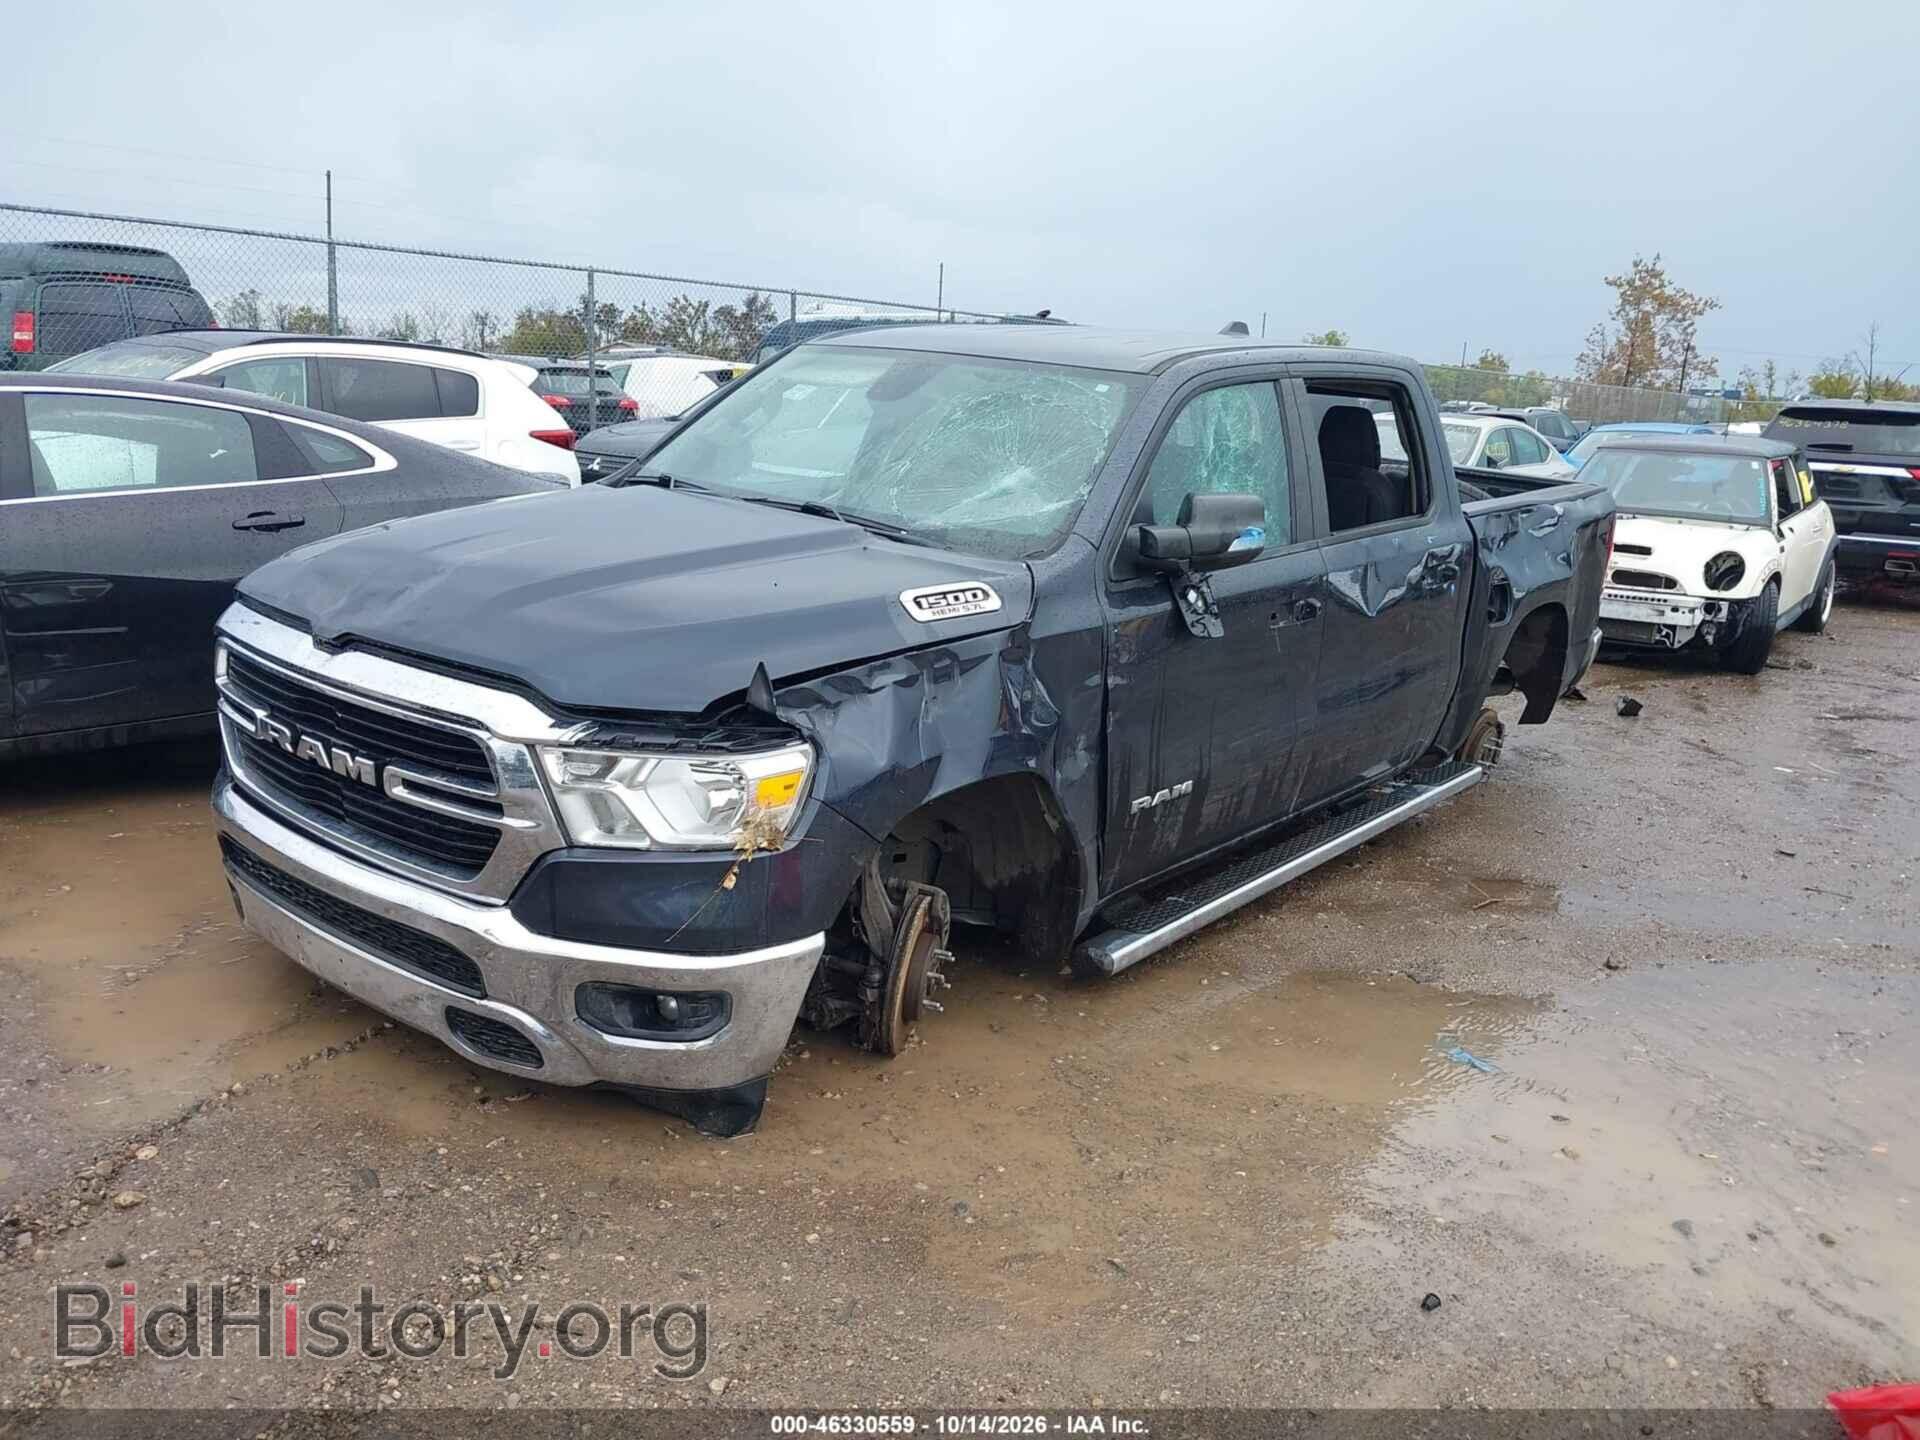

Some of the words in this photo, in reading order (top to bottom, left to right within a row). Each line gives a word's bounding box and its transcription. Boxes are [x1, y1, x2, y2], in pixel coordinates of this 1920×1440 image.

[914, 589, 985, 610] 1500
[931, 607, 960, 617] HEMI
[962, 603, 985, 612] 5.7L
[256, 715, 377, 787] RAM
[1130, 779, 1193, 815] RAM
